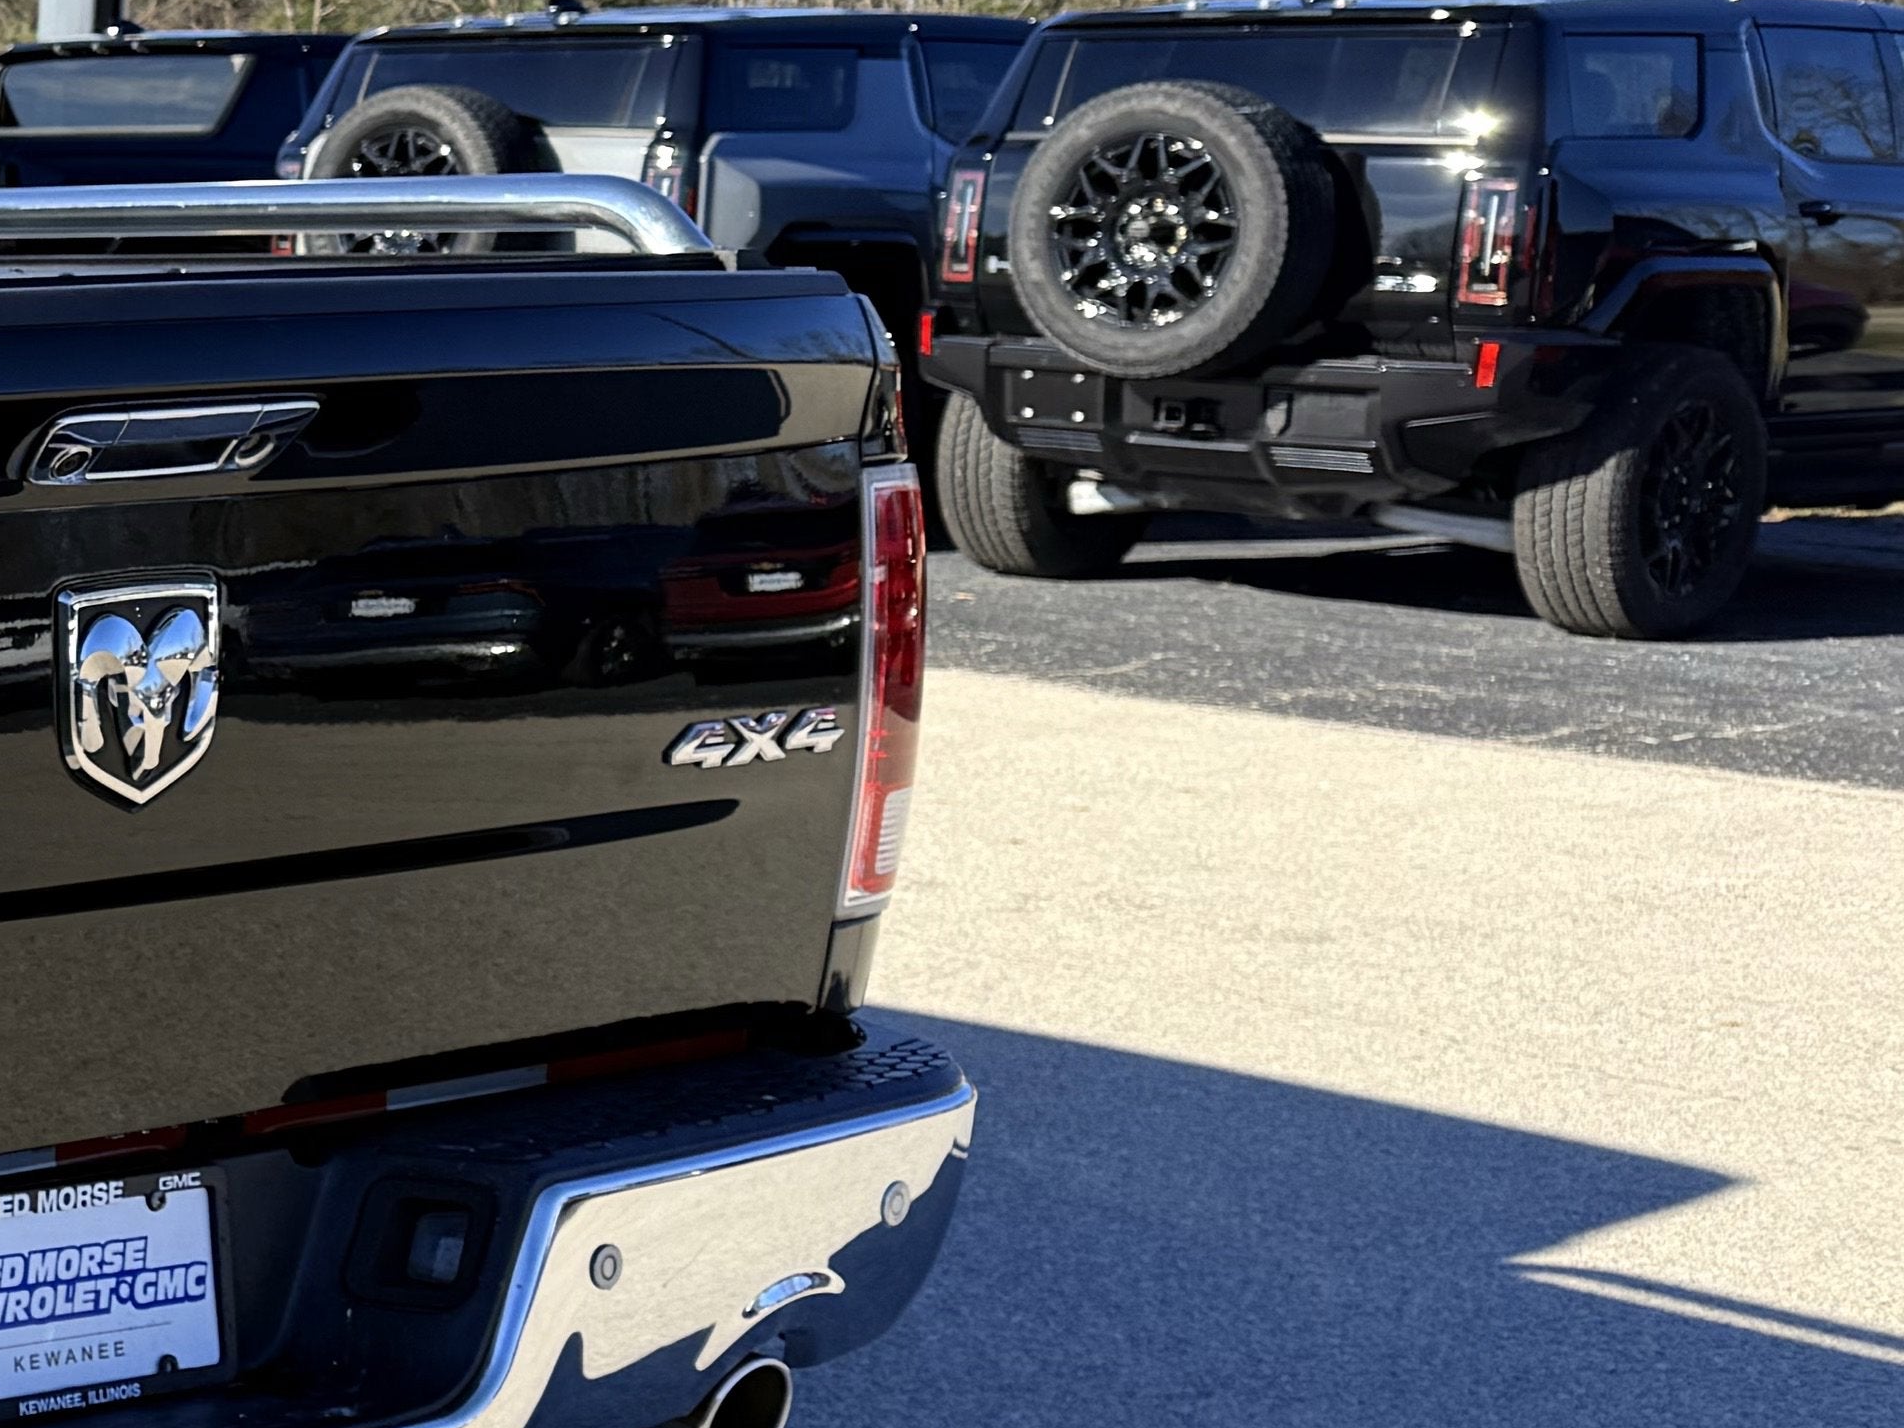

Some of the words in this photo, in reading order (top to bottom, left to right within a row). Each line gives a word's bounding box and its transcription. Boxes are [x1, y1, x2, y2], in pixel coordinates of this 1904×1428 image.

[37, 1180, 125, 1214] MORSE
[158, 1172, 202, 1191] GMC
[26, 1236, 148, 1286] MORSE
[13, 1339, 126, 1373] KEWANEE
[18, 1391, 87, 1417] KEWANEE,
[87, 1382, 142, 1405] ILLINOIS
